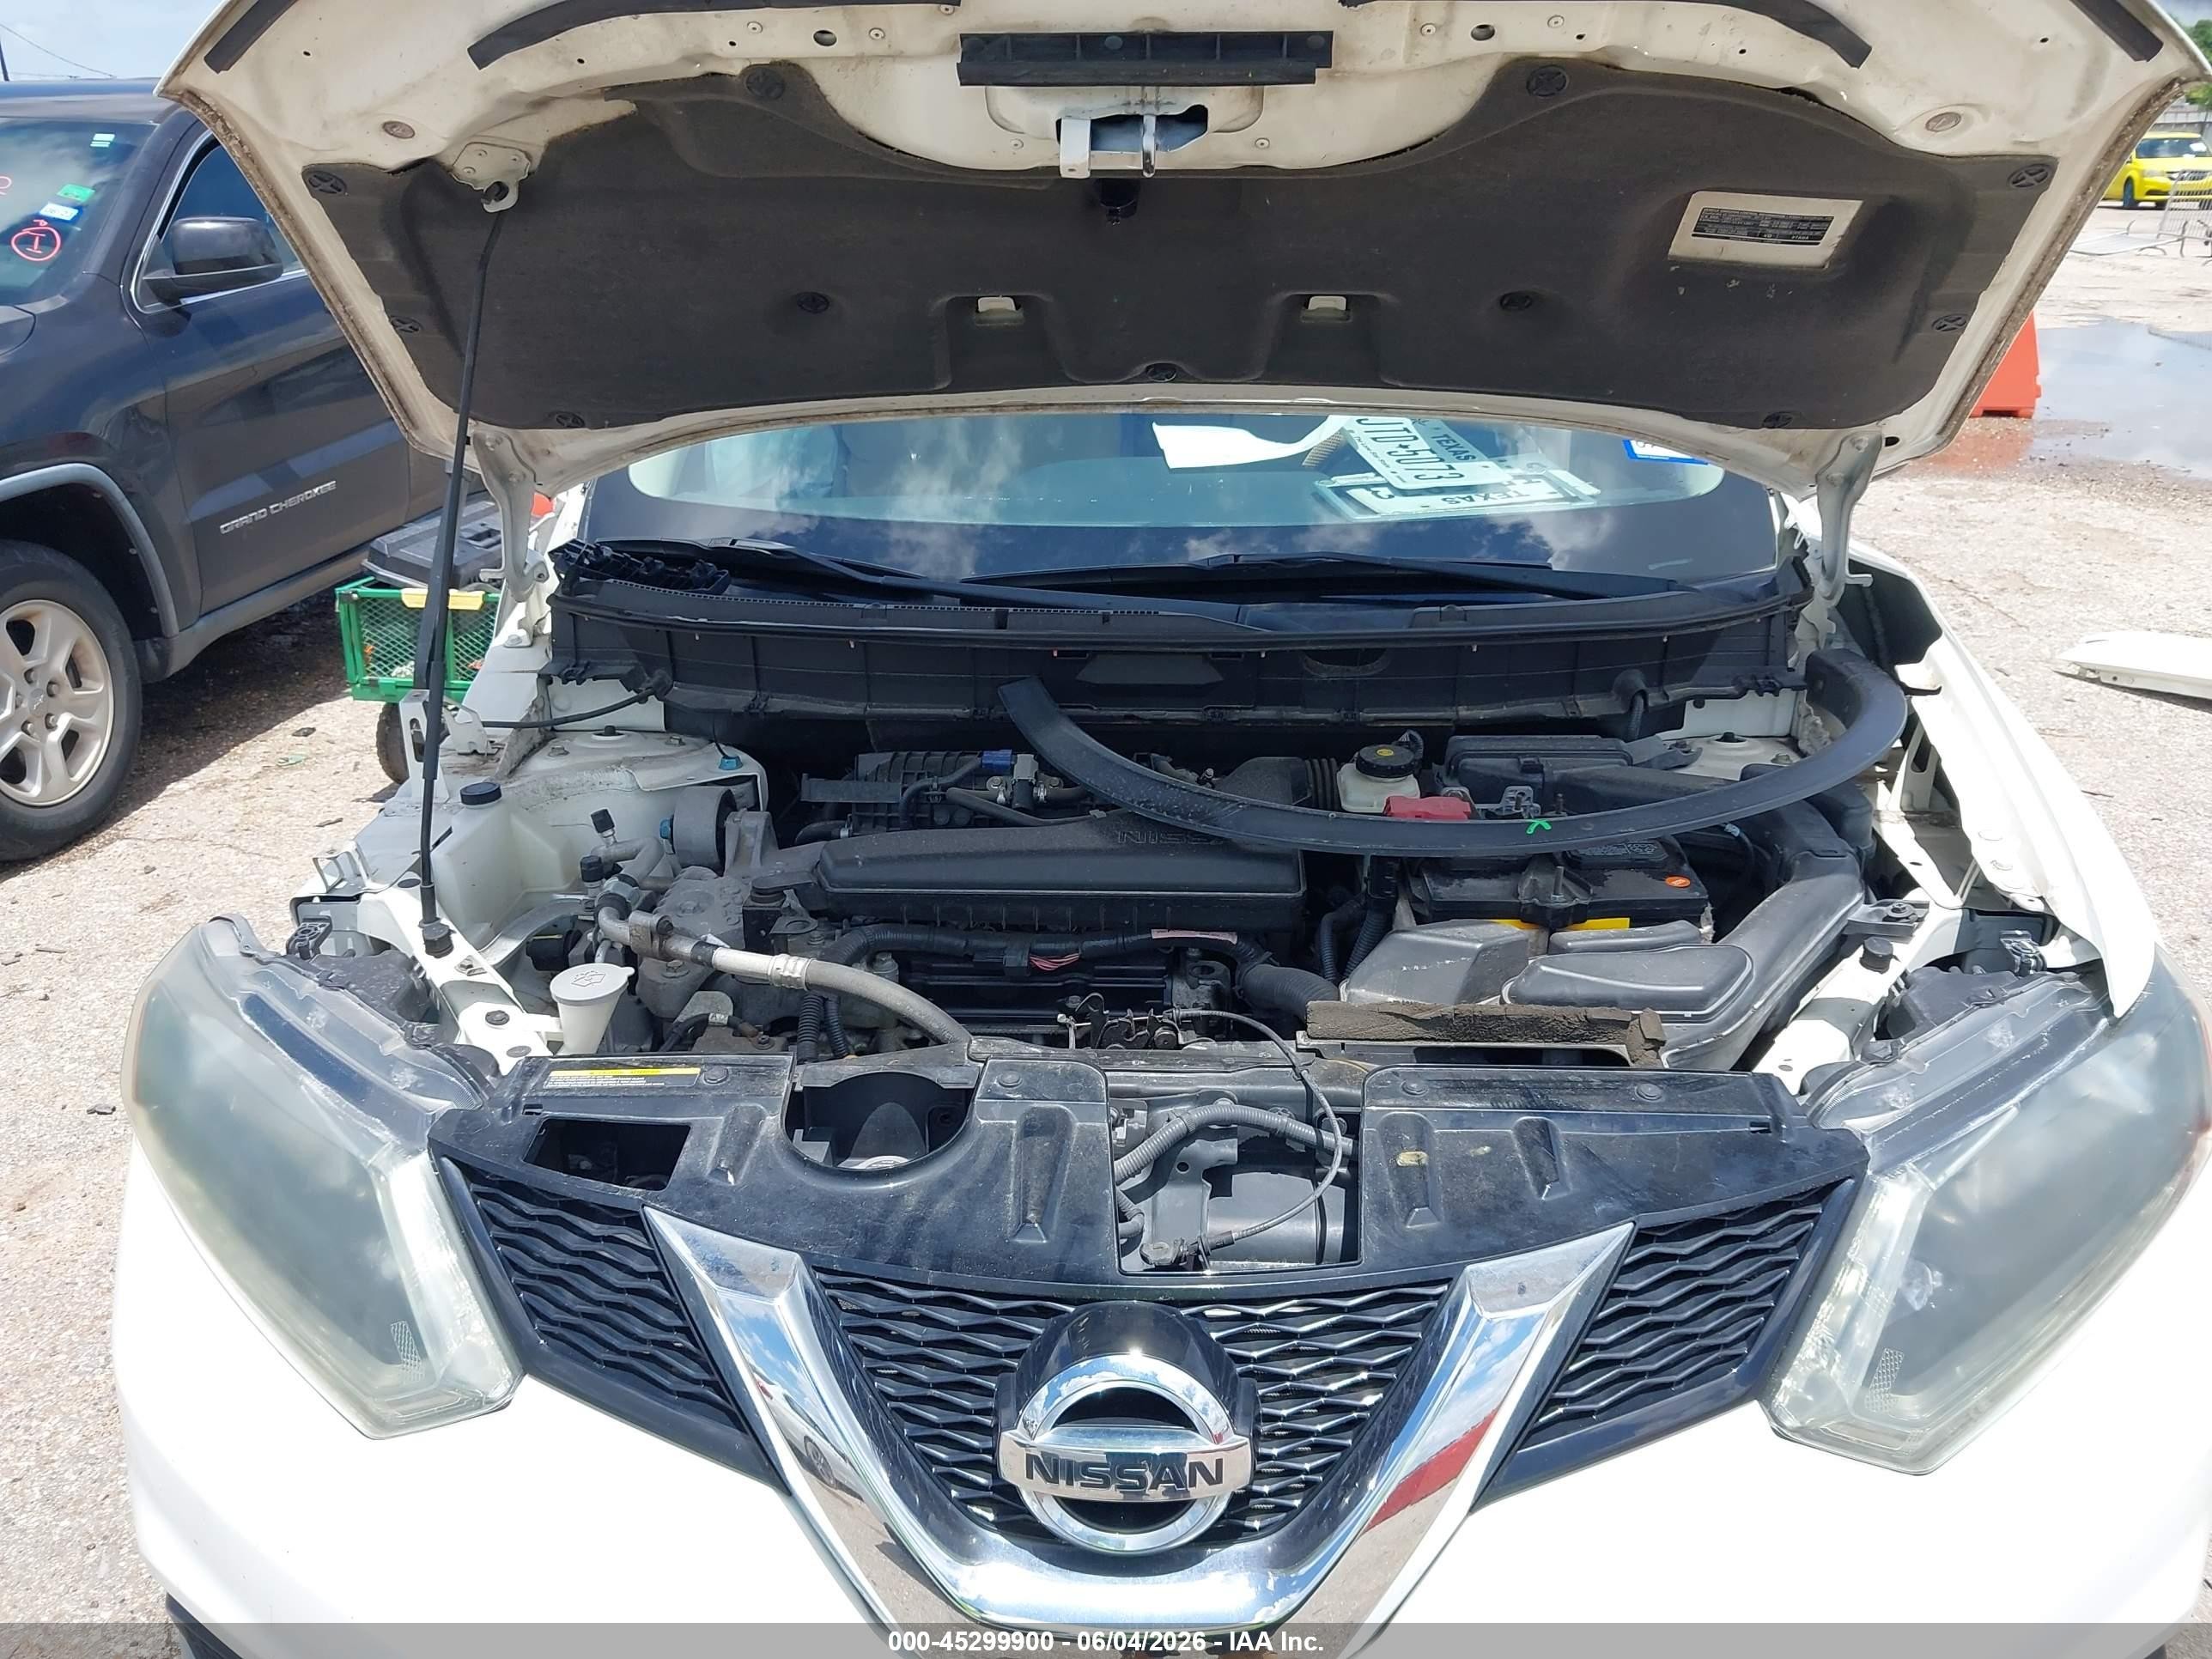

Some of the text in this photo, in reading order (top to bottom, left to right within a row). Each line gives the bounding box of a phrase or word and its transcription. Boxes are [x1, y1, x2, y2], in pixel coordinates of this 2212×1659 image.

[1431, 434, 1476, 461] TEXAS
[220, 480, 337, 534] GRAND CHEROKEE
[1442, 489, 1530, 505] TEXAS
[1117, 830, 1224, 845] NISS
[1025, 1452, 1224, 1492] NISSAN
